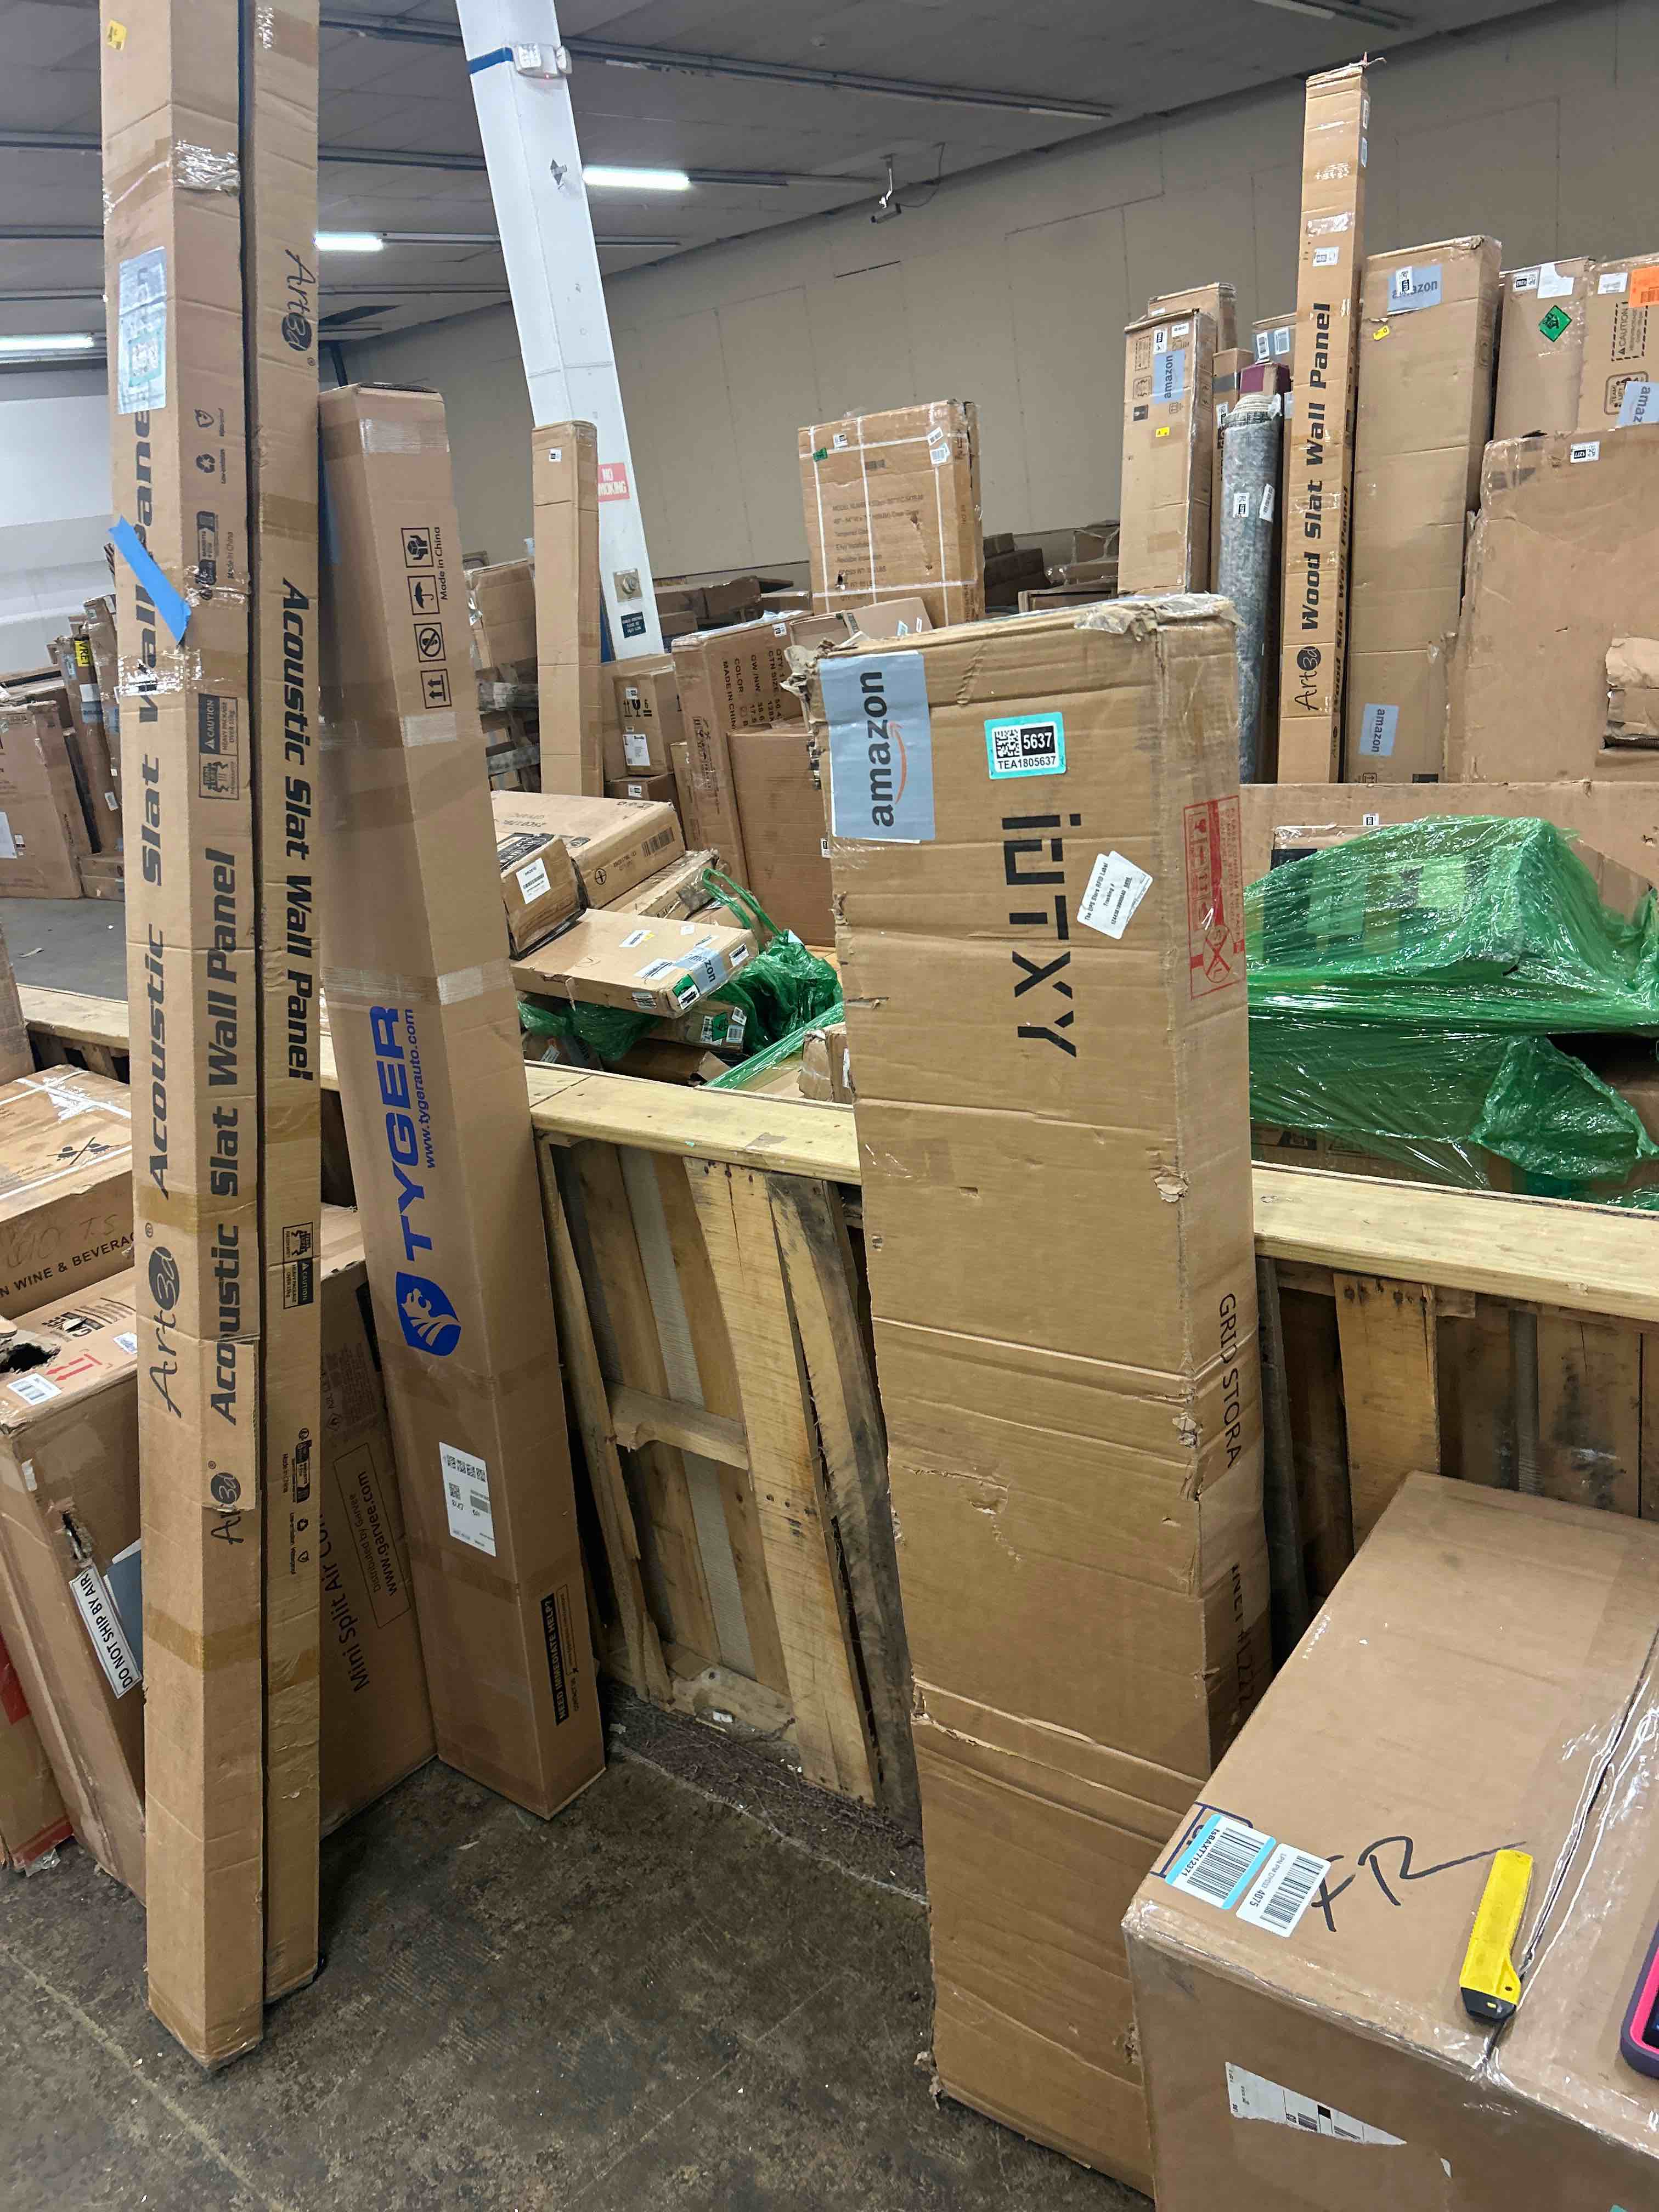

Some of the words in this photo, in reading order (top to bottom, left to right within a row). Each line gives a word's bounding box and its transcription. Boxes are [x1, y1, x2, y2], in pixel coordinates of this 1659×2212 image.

[1392, 279, 1438, 300] aazon
[1310, 303, 1330, 390] Panel
[1164, 354, 1173, 399] amazon
[1307, 402, 1326, 466] Wall
[1304, 479, 1323, 539] Slat
[435, 527, 443, 565] China
[439, 575, 448, 600] Made
[1301, 551, 1321, 630] Wood
[282, 578, 311, 766] Acoustic
[723, 660, 732, 690] MADE
[729, 703, 737, 730] CHIN
[206, 699, 216, 737] CAUTION
[1022, 732, 1053, 751] 5637
[1372, 708, 1386, 754] amazon
[860, 670, 896, 828] amazon
[997, 755, 1057, 770] TEA1805637
[140, 753, 162, 887] Slat
[285, 775, 312, 861] Slat
[205, 847, 238, 985] Panel
[286, 874, 312, 959] Wall
[207, 994, 238, 1087] Wall
[287, 972, 313, 1081] Panel
[149, 923, 170, 1200] Acoustic
[405, 1009, 435, 1169] www.tygerauto.com
[210, 1105, 239, 1197] Slat
[369, 1005, 433, 1262] TYGER
[14, 1266, 54, 1291] WINE
[58, 1261, 69, 1274] &
[210, 1223, 241, 1426] Acoustic
[1218, 1293, 1238, 1364] GRID
[357, 1470, 398, 1596] www.garvee.com
[80, 1573, 97, 1597] AIR
[321, 1562, 343, 1592] Air
[362, 1541, 381, 1593] Distributed
[88, 1596, 102, 1616] BY
[95, 1615, 114, 1643] SHIP
[330, 1593, 359, 1644] Split
[106, 1641, 125, 1669] NOT
[118, 1667, 133, 1689] DO
[342, 1643, 370, 1693] Mini
[555, 1691, 567, 1721] NEED
[1249, 1888, 1266, 1907] 4075
